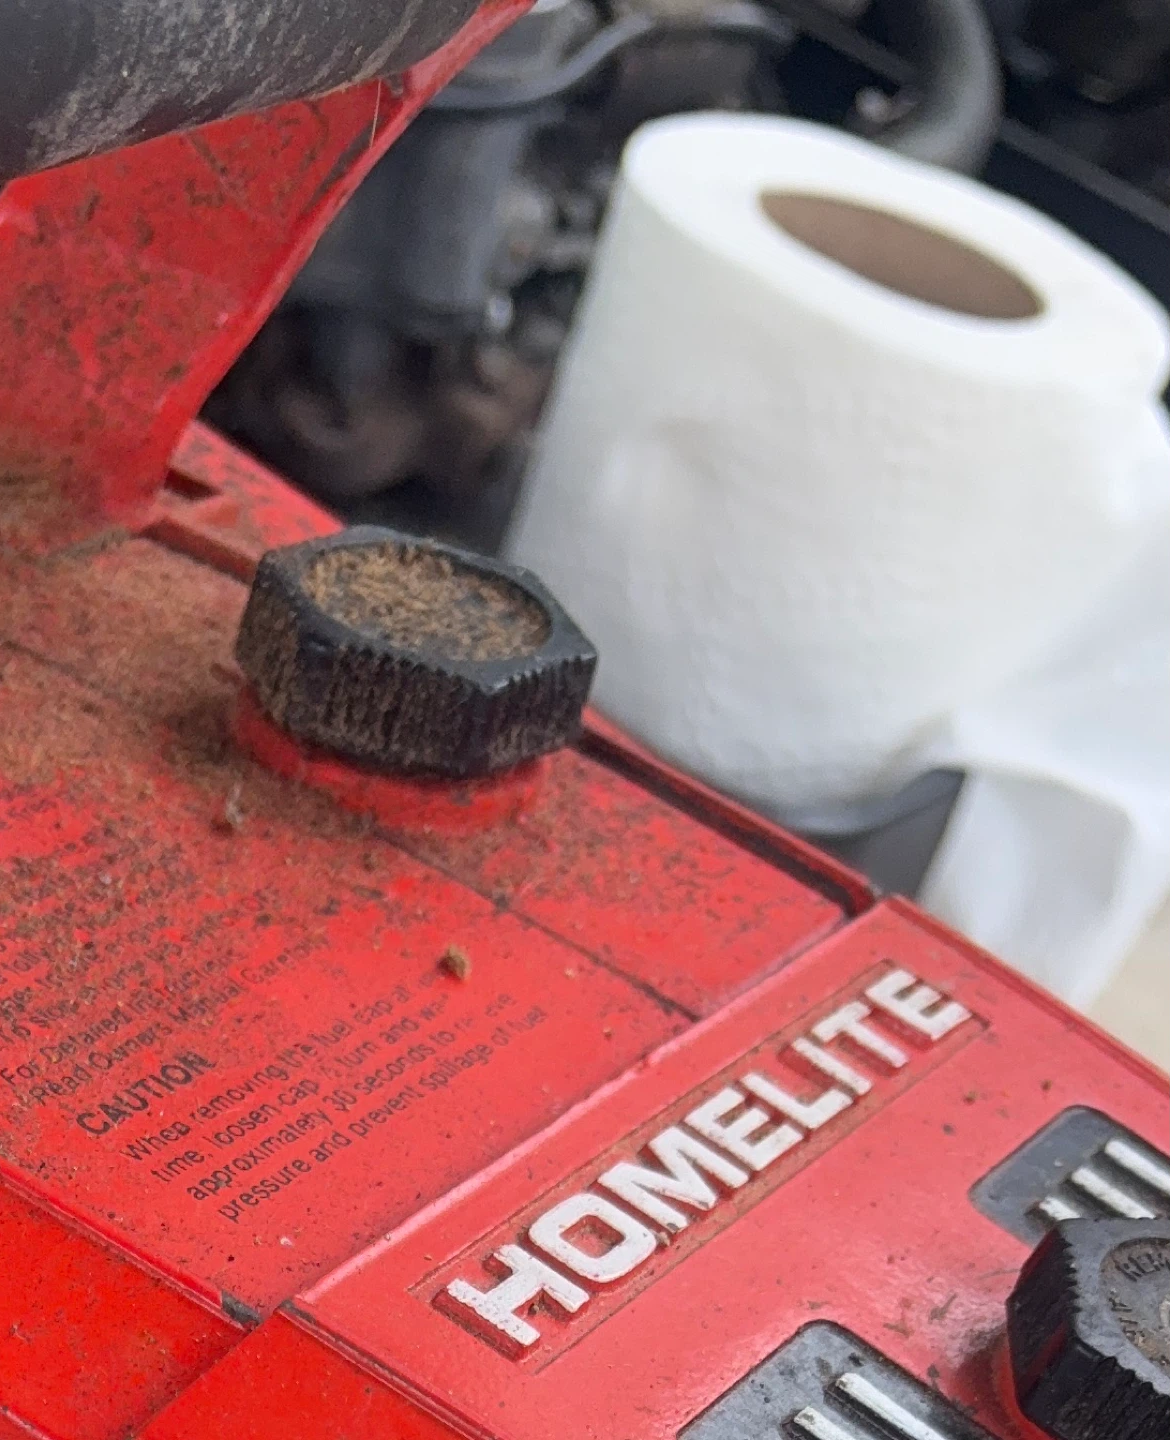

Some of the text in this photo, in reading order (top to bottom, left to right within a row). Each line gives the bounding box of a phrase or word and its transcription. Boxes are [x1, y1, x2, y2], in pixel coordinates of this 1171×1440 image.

[77, 1050, 217, 1135] CAUTION
[120, 1121, 192, 1161] When
[189, 1064, 290, 1125] removing
[279, 1039, 318, 1069] the
[308, 1018, 354, 1048] fuel
[353, 999, 394, 1026] cap
[150, 1149, 215, 1183] time,
[201, 1103, 284, 1151] loosen
[277, 1078, 320, 1107] cap
[335, 1040, 379, 1069] turn
[379, 1015, 420, 1045] and
[187, 1106, 334, 1201] approximately
[323, 1088, 358, 1113] 30
[354, 1042, 437, 1096] seconds
[430, 1029, 457, 1048] to
[217, 1157, 311, 1225] pressure
[309, 1130, 354, 1162] and
[348, 1084, 425, 1140] prevent
[418, 1043, 495, 1092] spillage
[490, 1025, 515, 1048] of
[440, 967, 974, 1352] HOMELITE
